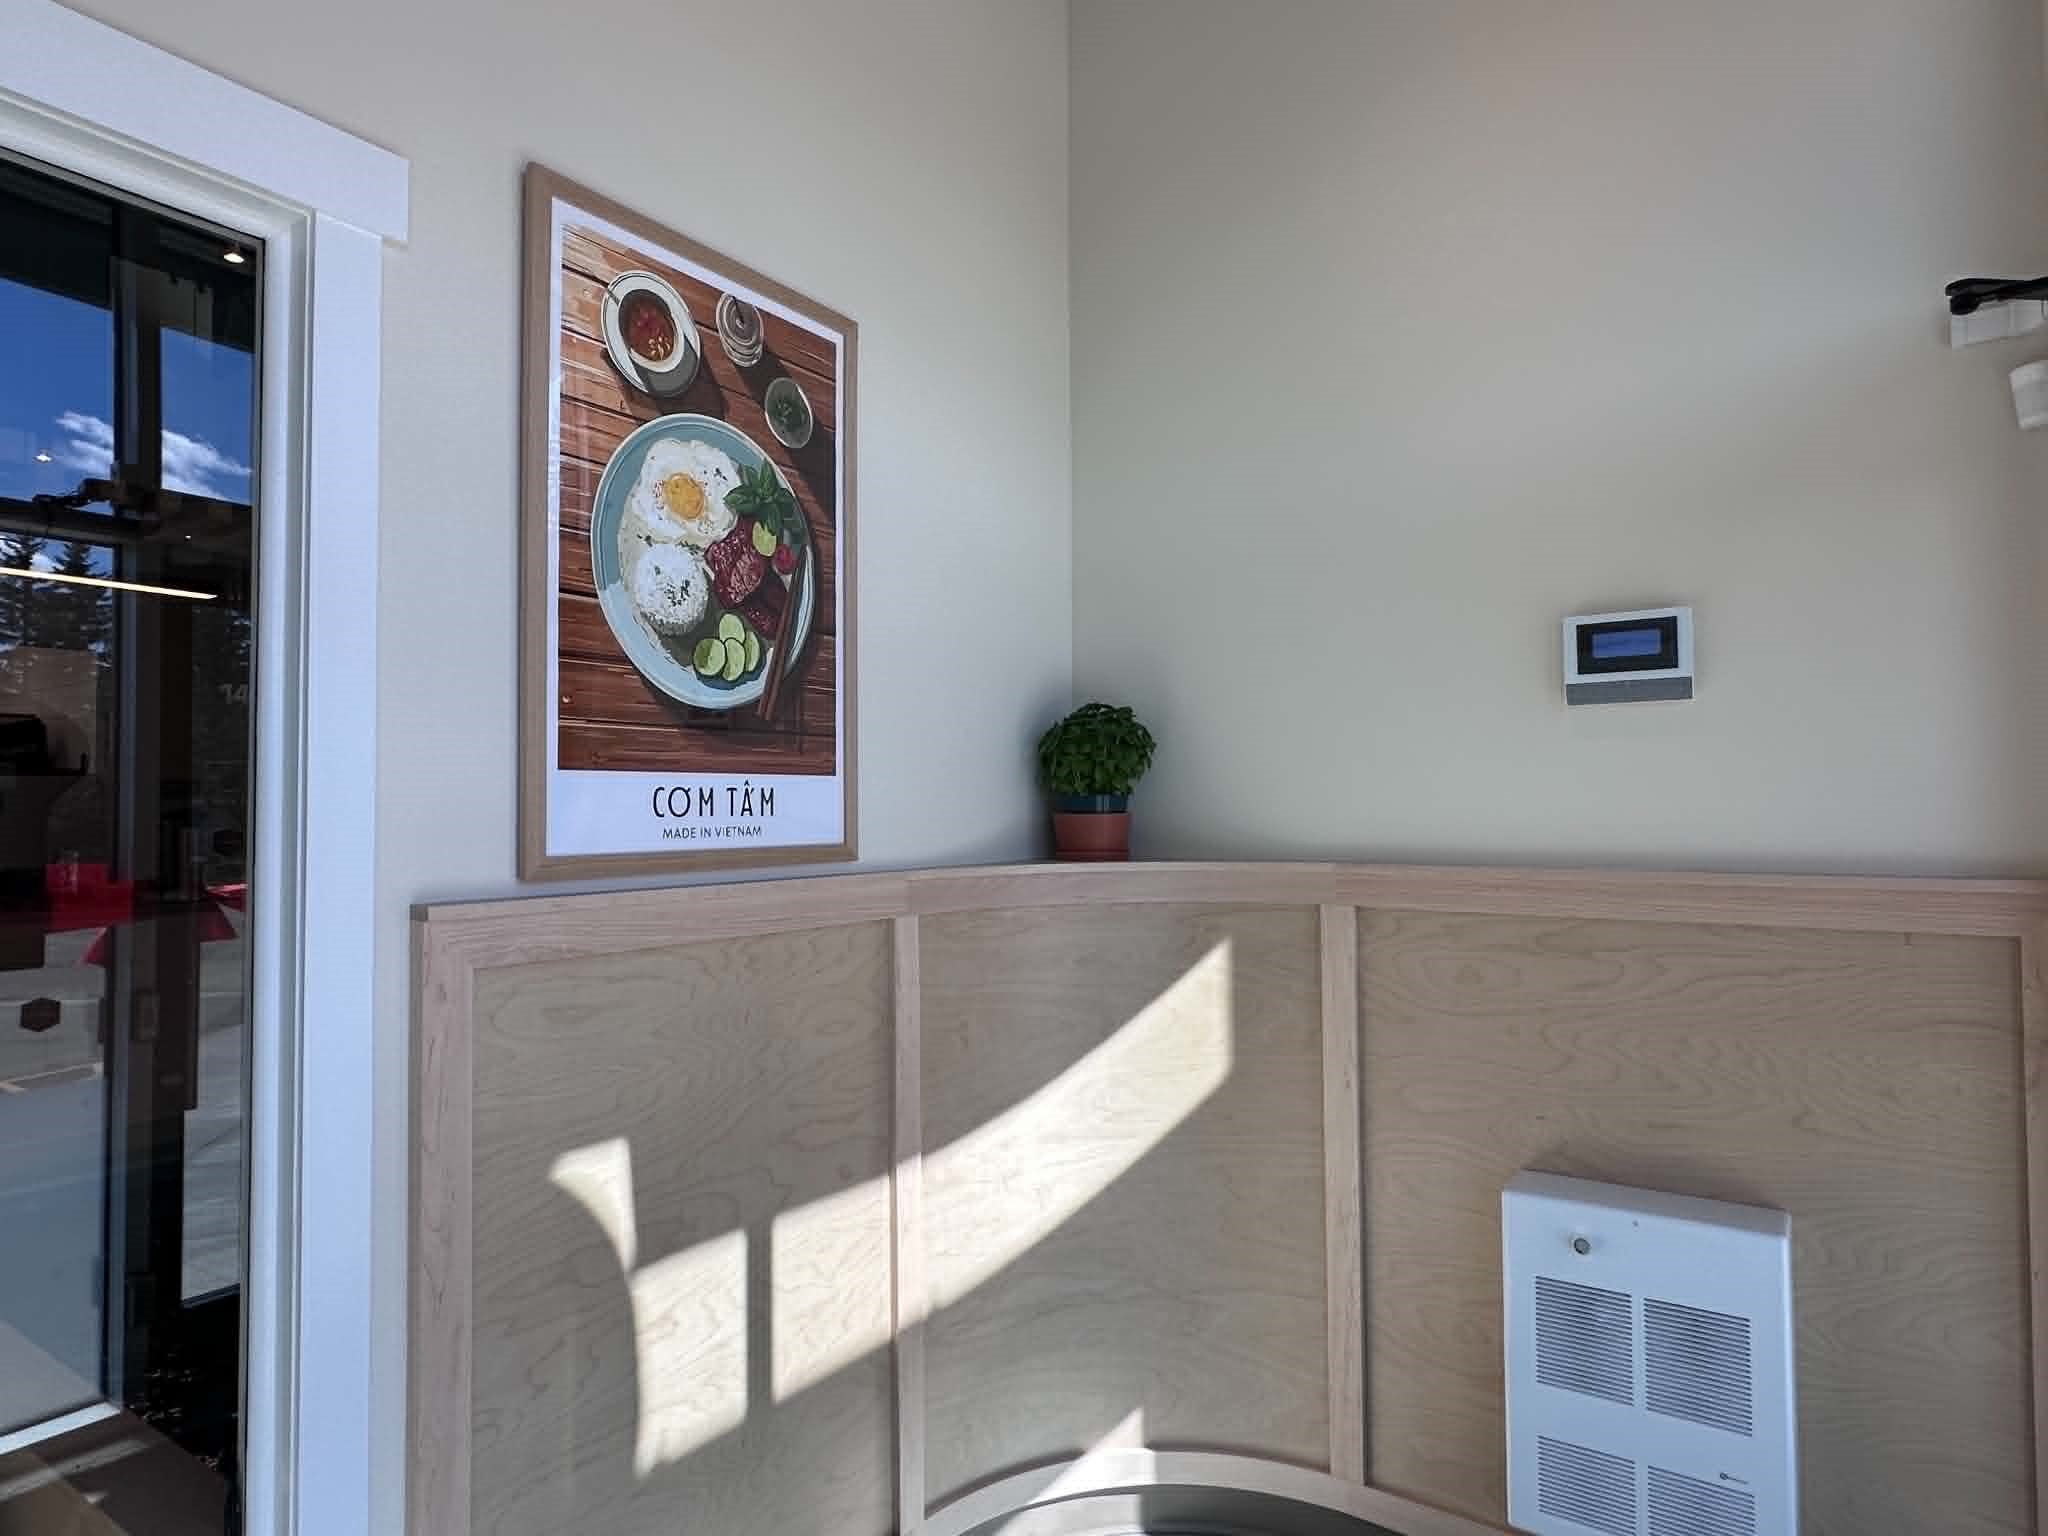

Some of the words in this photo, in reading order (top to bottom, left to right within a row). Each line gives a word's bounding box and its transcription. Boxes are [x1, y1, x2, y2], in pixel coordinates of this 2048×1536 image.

[652, 786, 714, 818] CƠM
[662, 827, 696, 839] MADE
[700, 827, 711, 838] IN
[714, 825, 761, 838] VIETNAM
